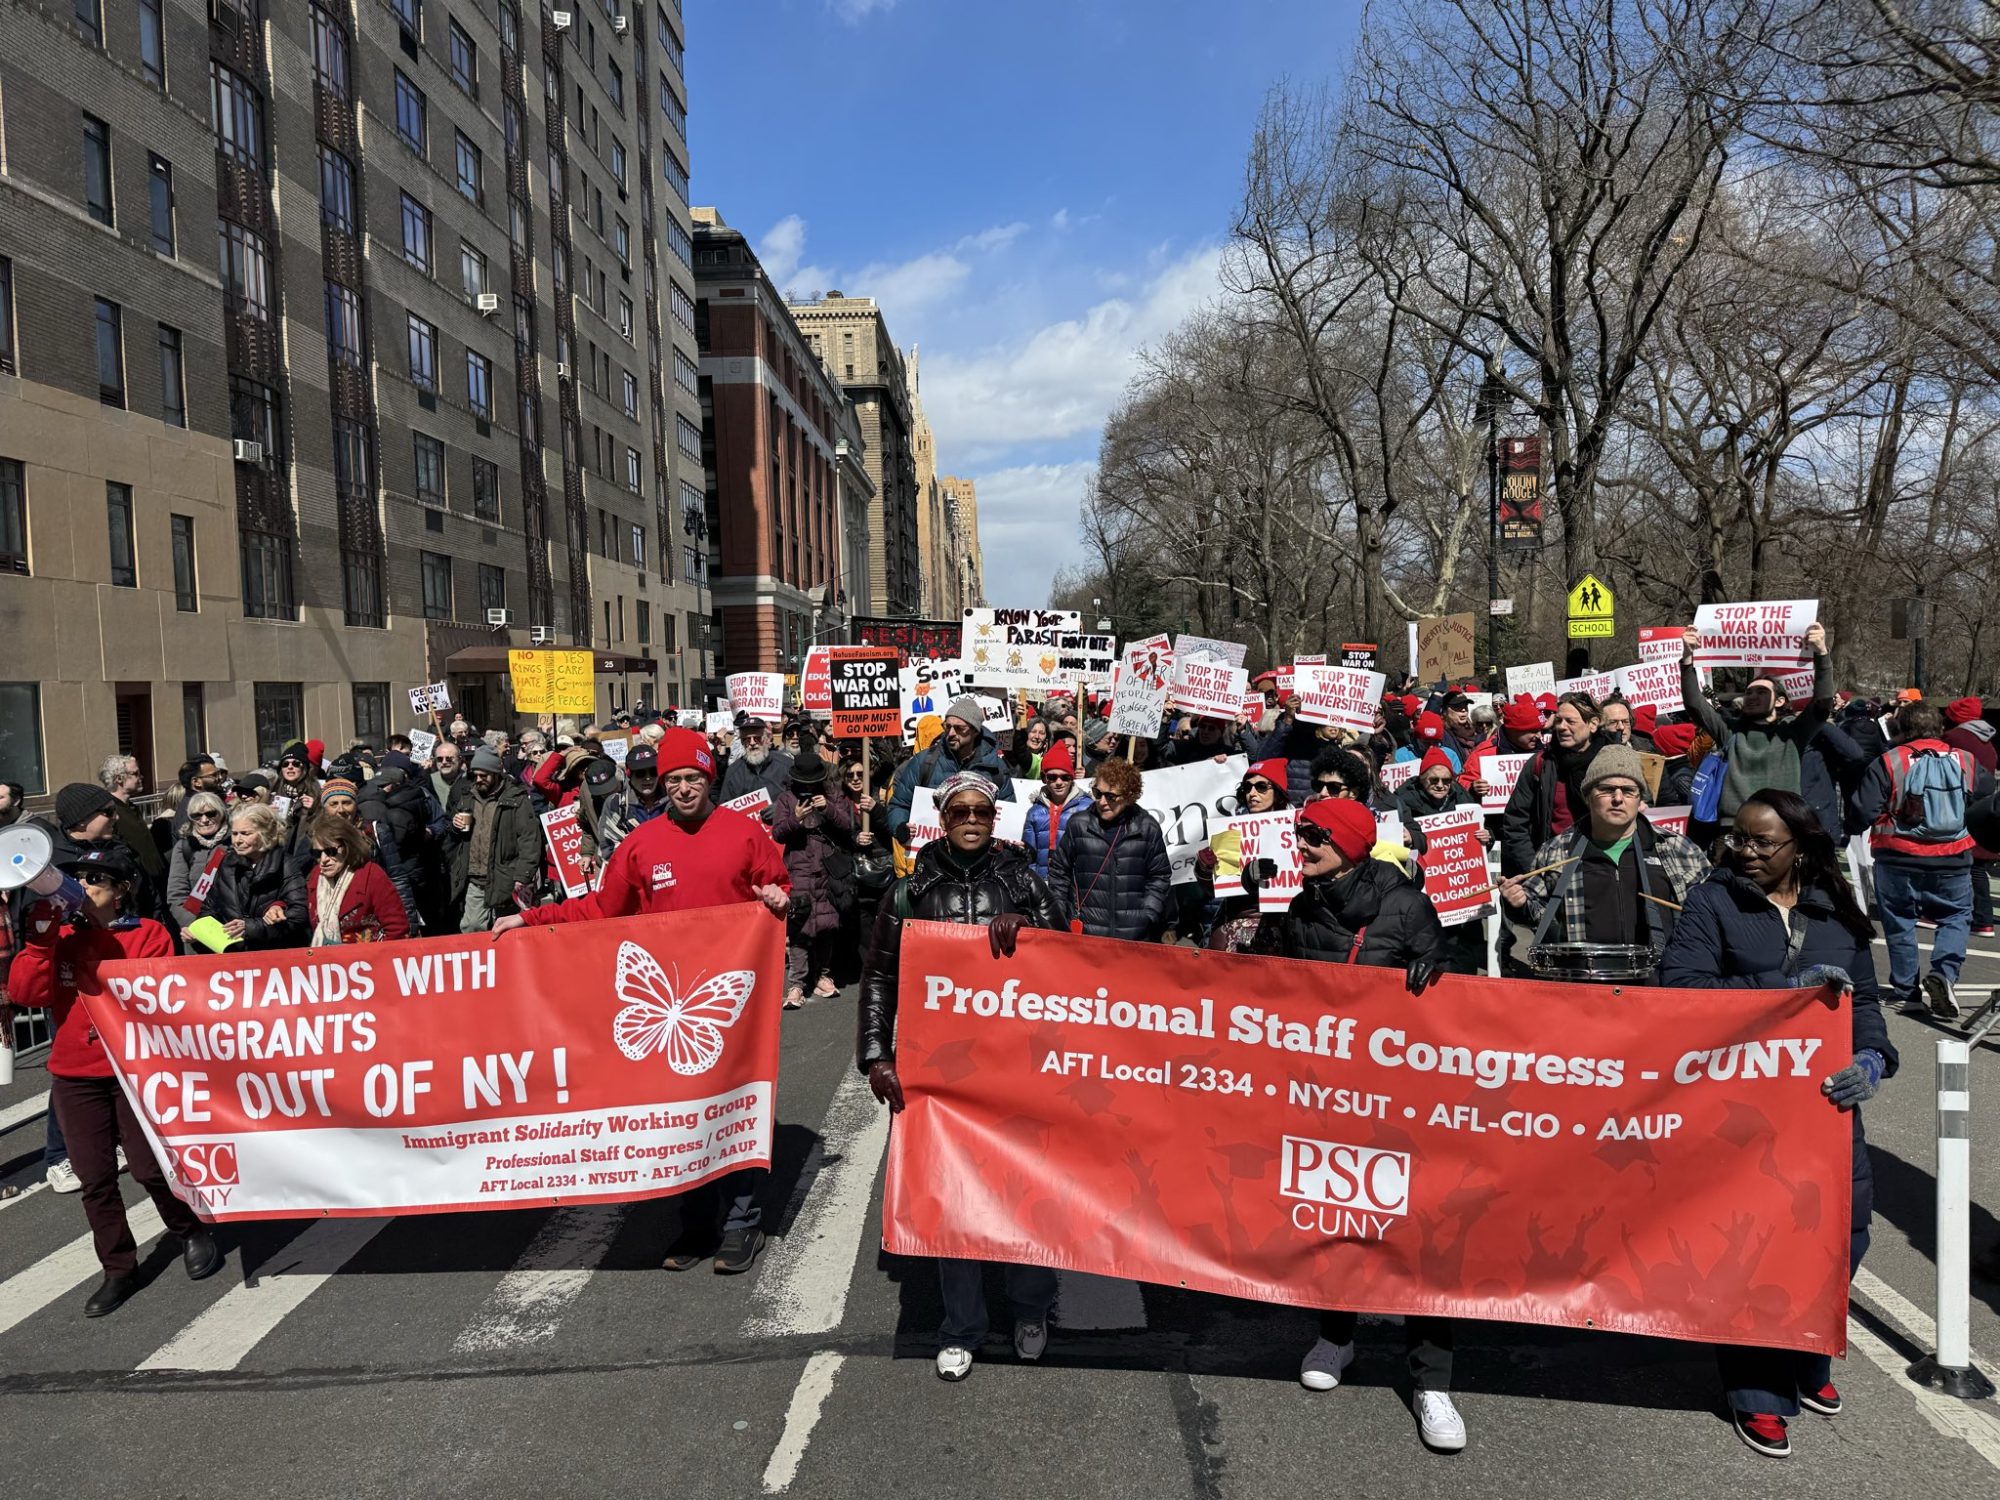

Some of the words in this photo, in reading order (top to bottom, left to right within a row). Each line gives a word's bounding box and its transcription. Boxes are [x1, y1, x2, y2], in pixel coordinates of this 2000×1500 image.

[993, 609, 1030, 626] KNOW
[1714, 607, 1756, 619] STOP
[1760, 605, 1793, 619] THE
[1572, 624, 1610, 633] SCHOOL
[1720, 620, 1758, 634] WAR
[1762, 620, 1785, 634] ON
[1089, 636, 1109, 651] BITE
[1420, 622, 1442, 652] LIBERTY
[1449, 620, 1474, 643] JUSTICE
[1348, 651, 1370, 659] STOP
[1640, 643, 1659, 655] TAX
[1661, 641, 1682, 652] THE
[518, 651, 534, 660] NO
[562, 652, 585, 664] YES
[604, 660, 614, 668] 25
[1342, 659, 1361, 667] WAR
[1362, 660, 1375, 668] ON
[1426, 656, 1440, 668] FOR
[1454, 650, 1469, 662] ALL
[511, 662, 542, 674] KINGS
[558, 665, 585, 675] CARE
[843, 662, 887, 677] STOP
[1089, 658, 1113, 673] THAT
[1184, 663, 1211, 676] STOP
[1213, 668, 1234, 682] THE
[1536, 667, 1550, 677] ALL
[516, 676, 542, 688] HATE
[729, 677, 746, 689] STOP
[748, 675, 769, 687] THE
[1126, 675, 1140, 687] OF
[1278, 676, 1290, 684] TAX
[1312, 670, 1345, 683] STOP
[1348, 672, 1371, 689] THE
[1628, 667, 1659, 682] STOP
[1784, 674, 1815, 690] RICH
[427, 684, 445, 694] OUT
[833, 679, 870, 692] WAR
[874, 677, 898, 692] ON
[1187, 675, 1212, 689] WAR
[1213, 681, 1230, 692] ON
[1318, 681, 1347, 696] WAR
[1348, 686, 1366, 700] ON
[1569, 680, 1593, 691] STOP
[1596, 675, 1611, 686] THE
[1598, 685, 1609, 695] ON
[1636, 677, 1667, 691] WAR
[733, 687, 748, 698] WAR
[750, 686, 765, 697] ON
[1115, 690, 1154, 703] PEOPLE
[1173, 682, 1243, 707] UNIVERSITIES!
[558, 694, 590, 706] PEACE
[844, 693, 888, 707] IRAN!
[836, 714, 869, 724] TRUMP
[871, 712, 899, 722] MUST
[846, 726, 861, 734] GO
[863, 724, 889, 733] NOW!
[1390, 766, 1412, 779] THE
[552, 823, 582, 841] SAVE
[1430, 832, 1469, 849] MONEY
[1443, 847, 1465, 860] FOR
[652, 862, 672, 874] PSC
[1425, 857, 1483, 878] EDUCATION
[1448, 873, 1470, 887] NOT
[106, 974, 187, 1015] PSC
[207, 961, 375, 1011] STANDS
[392, 948, 496, 997] WITH
[124, 1011, 377, 1061] IMMIGRANTS
[923, 975, 1216, 1039] Professional
[1228, 1005, 1358, 1061] Staff
[1368, 1026, 1626, 1090] Congress
[1673, 1037, 1823, 1085] CUNY
[236, 1068, 334, 1120] OUT
[363, 1060, 433, 1118] OF
[462, 1050, 535, 1110] NY
[1039, 1050, 1094, 1077] AFT
[1101, 1055, 1172, 1085] Local
[1179, 1064, 1254, 1098] 2334
[1287, 1080, 1392, 1120] NYSUT
[1427, 1102, 1561, 1139] AFL-CIO
[1596, 1113, 1684, 1141] AAUP
[402, 1126, 510, 1150] Immigrant
[514, 1117, 603, 1142] Solidarity
[607, 1110, 699, 1134] Working
[703, 1093, 758, 1122] Group
[485, 1148, 577, 1170] Professional
[579, 1146, 620, 1163] Staff
[623, 1139, 704, 1160] Congress
[715, 1117, 758, 1142] CUNY
[479, 1180, 507, 1193] AFT
[509, 1177, 545, 1191] Local
[546, 1174, 577, 1188] 2334
[587, 1171, 639, 1186] NYSUT
[650, 1155, 711, 1180] AFL-CIO
[719, 1140, 758, 1158] AAUP
[1283, 1140, 1409, 1214] PSC
[1291, 1203, 1395, 1241] CUNY
